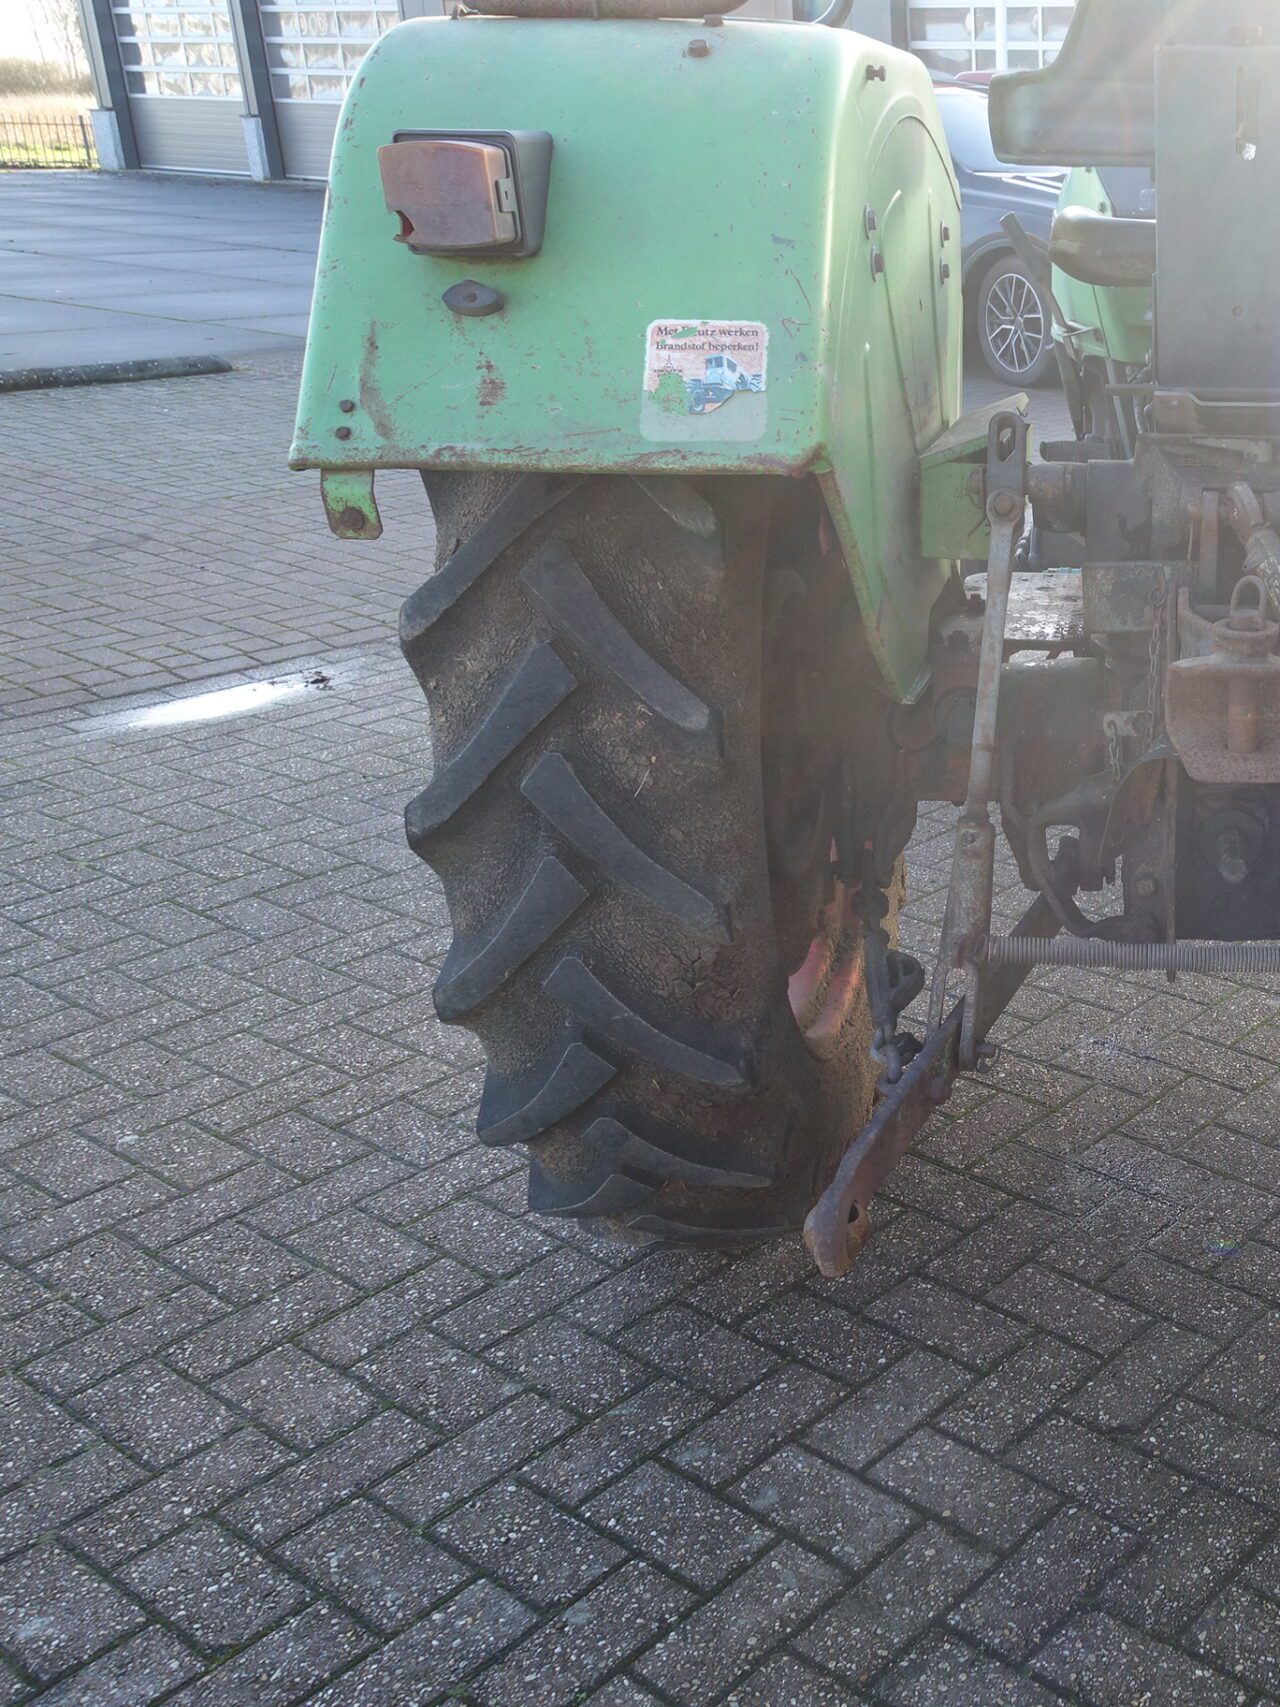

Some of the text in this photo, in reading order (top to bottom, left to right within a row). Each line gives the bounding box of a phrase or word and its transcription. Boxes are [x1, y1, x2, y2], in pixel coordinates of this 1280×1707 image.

[656, 326, 759, 338] Met utz werken
[656, 342, 759, 352] Brandstof beperken!
